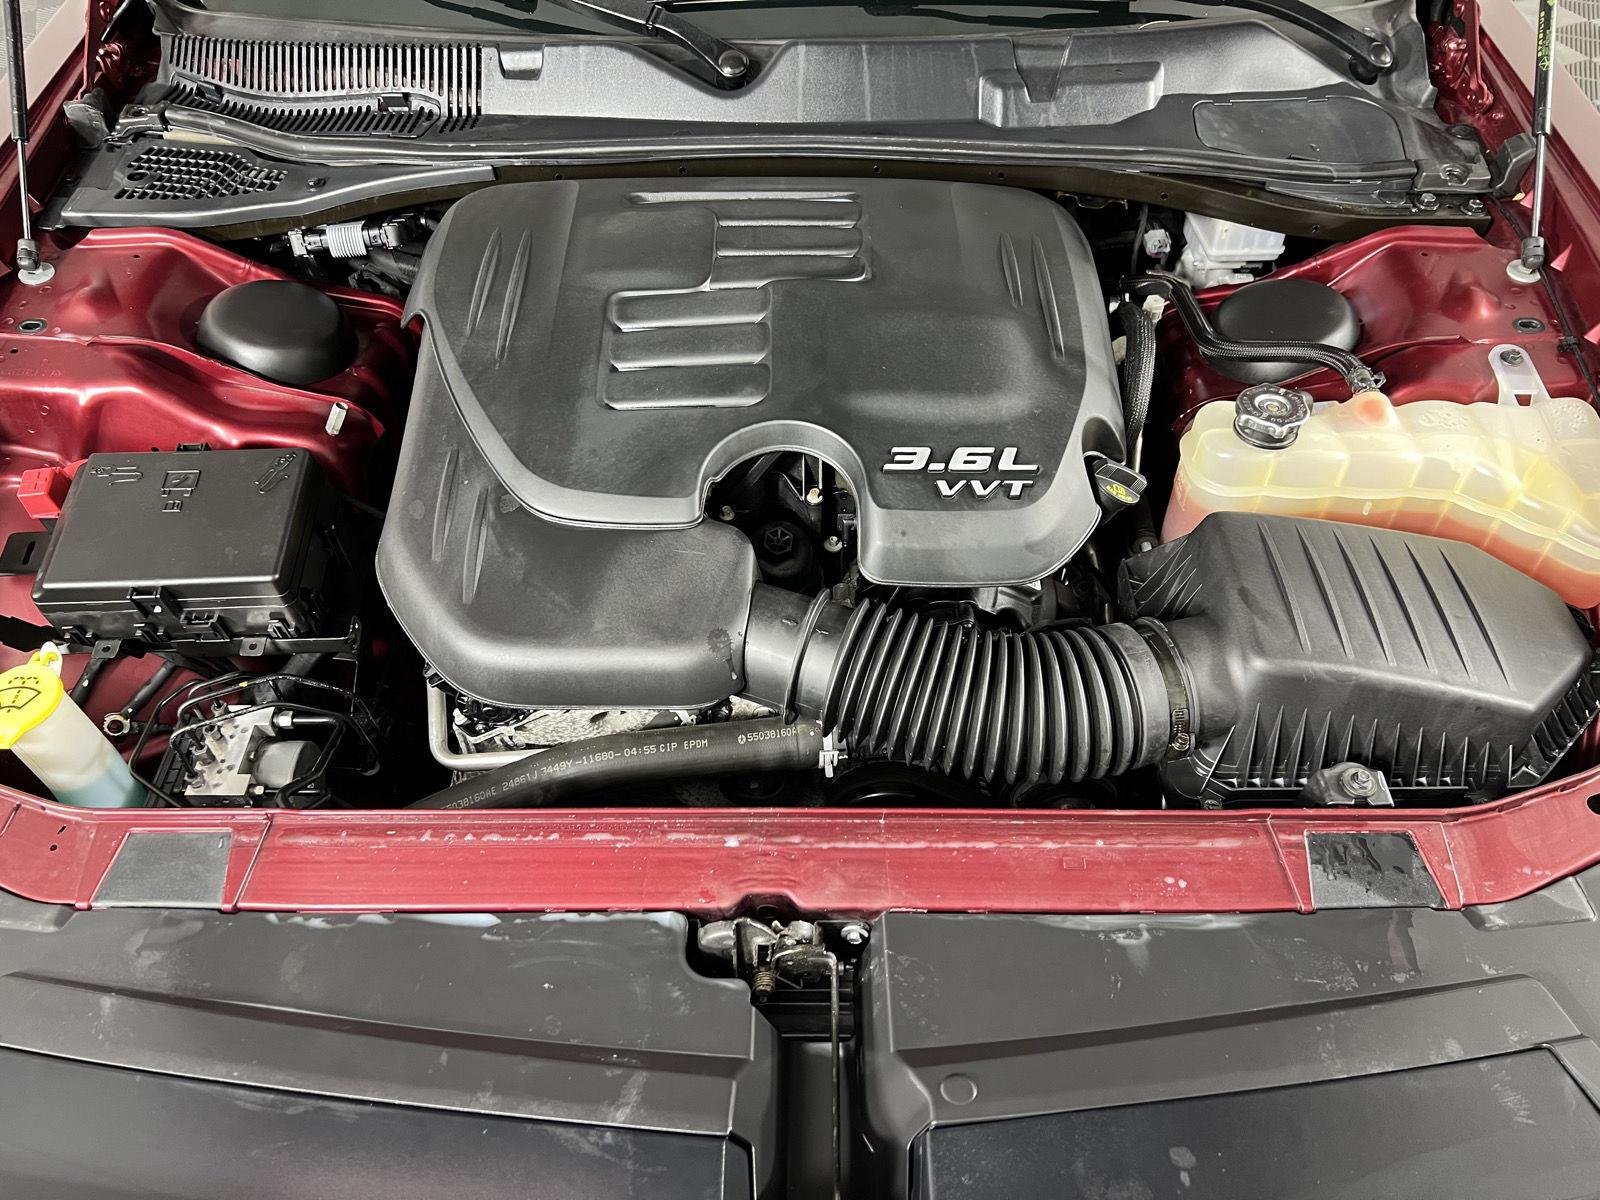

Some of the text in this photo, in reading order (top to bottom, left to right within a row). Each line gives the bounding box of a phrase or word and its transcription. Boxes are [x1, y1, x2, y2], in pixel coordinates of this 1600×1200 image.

[1537, 10, 1545, 57] STABILUS
[882, 446, 1040, 475] 3.6L
[935, 479, 1035, 500] VVT
[624, 745, 657, 757] 04:55
[683, 738, 708, 750] EPDM
